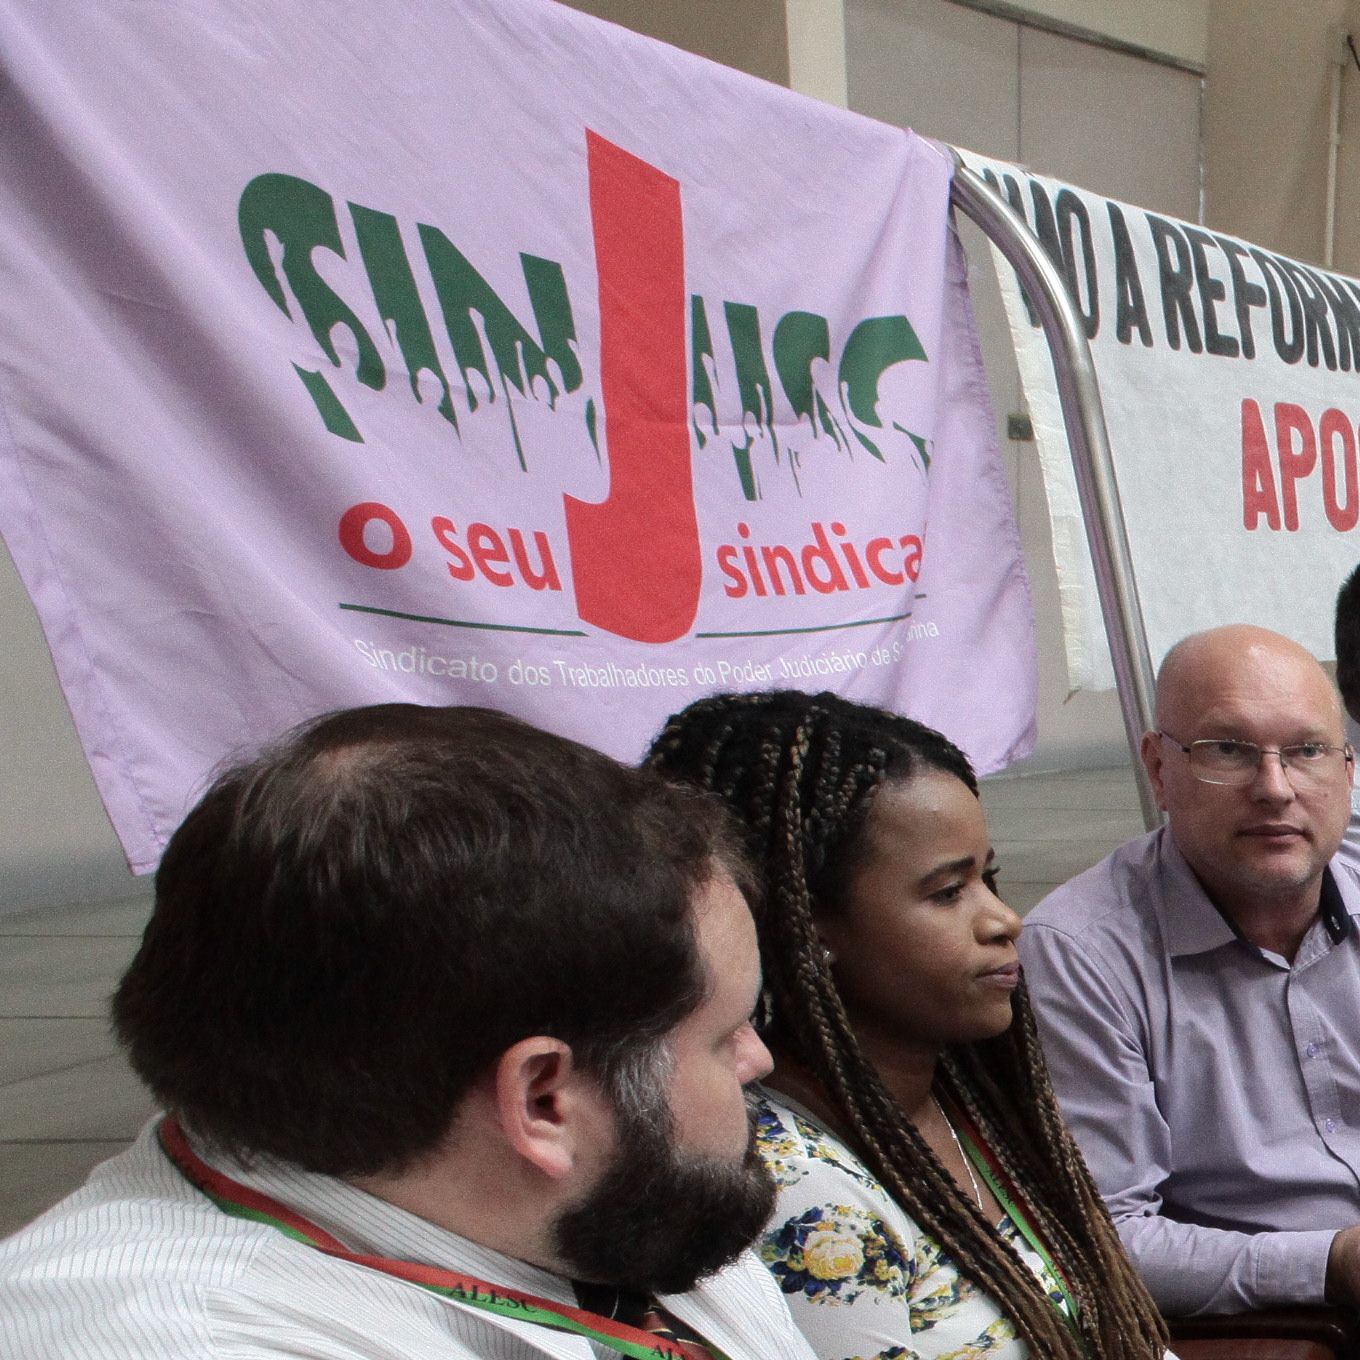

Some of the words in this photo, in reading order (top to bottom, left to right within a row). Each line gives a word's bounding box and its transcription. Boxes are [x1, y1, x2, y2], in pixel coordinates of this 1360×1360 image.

[1106, 200, 1154, 348] A
[338, 502, 412, 570] o
[431, 514, 563, 592] seu
[354, 639, 498, 684] Sindicato
[508, 659, 551, 686] dos
[554, 660, 689, 688] Trabalhadores
[693, 660, 717, 686] do
[718, 656, 773, 685] Poder
[779, 649, 868, 680] Judiciário
[871, 648, 891, 667] de
[448, 1281, 539, 1313] ALESC
